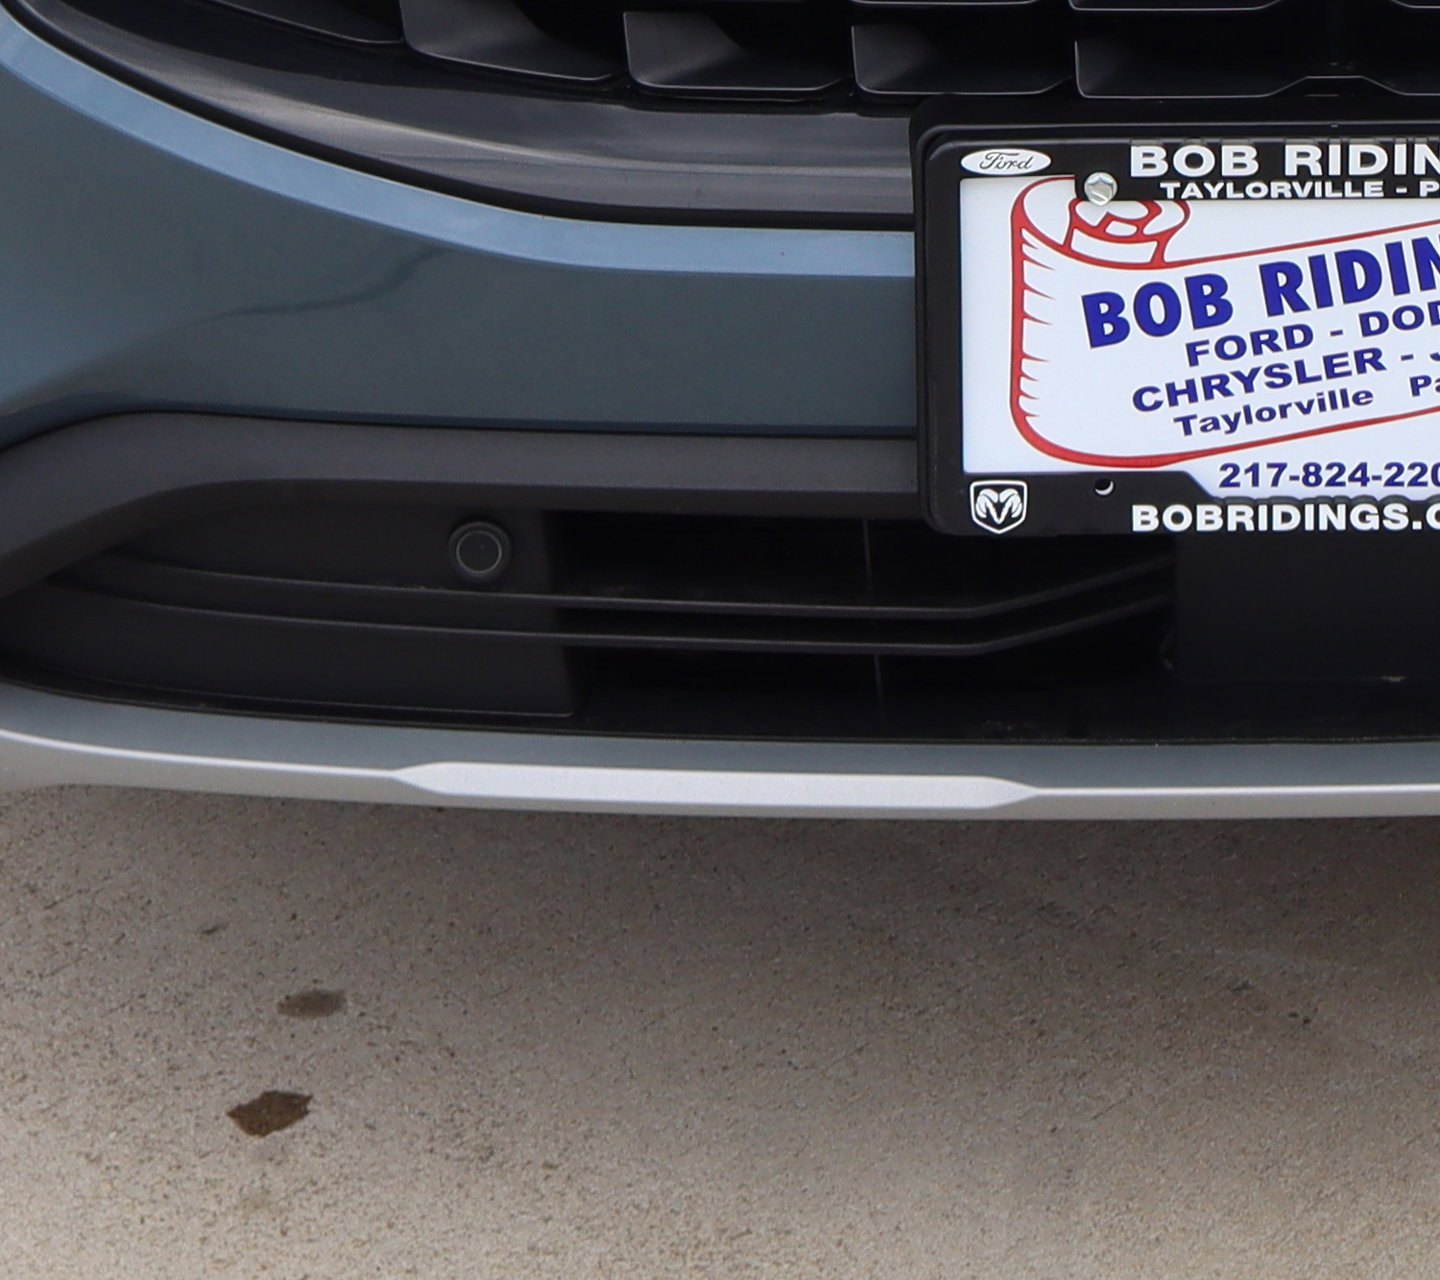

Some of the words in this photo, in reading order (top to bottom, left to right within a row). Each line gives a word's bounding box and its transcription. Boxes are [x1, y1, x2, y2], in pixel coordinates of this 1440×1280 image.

[979, 152, 1034, 172] Ford
[1130, 144, 1259, 177] BOB
[1160, 181, 1385, 199] TAYLORVILLE
[1081, 273, 1234, 348] BOB
[1186, 323, 1314, 367] FORD
[1133, 347, 1387, 412] CHRYSLER
[1174, 388, 1373, 435] Taylorville
